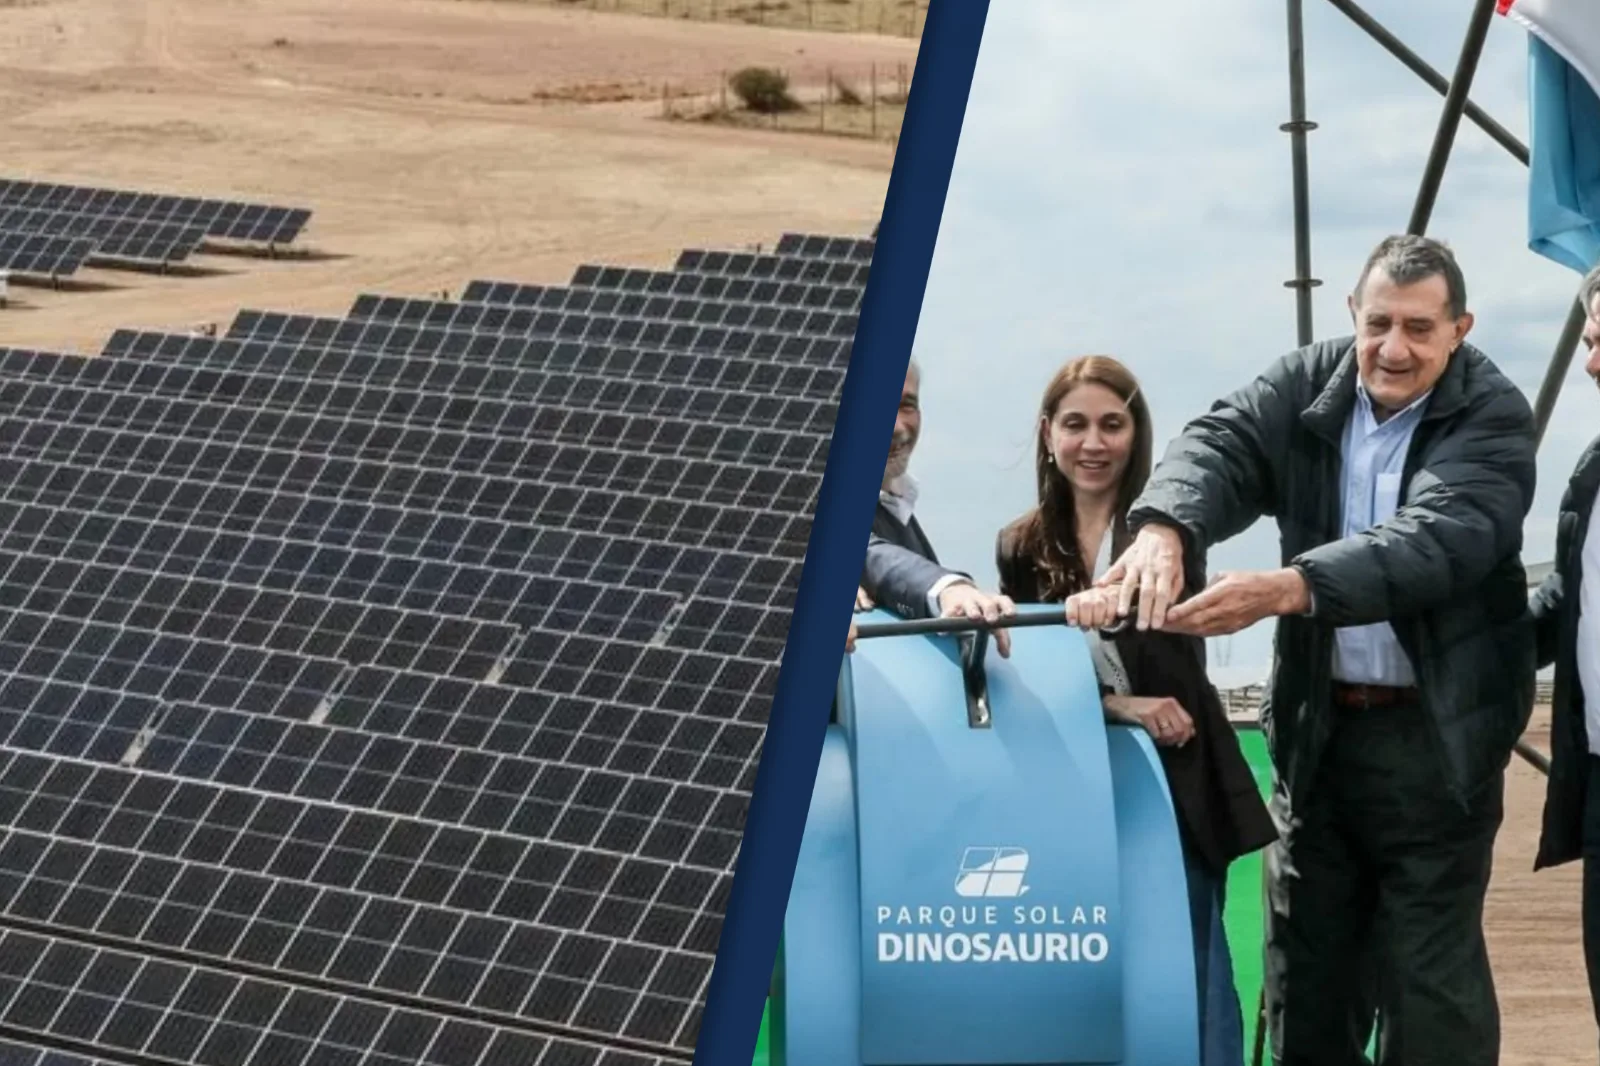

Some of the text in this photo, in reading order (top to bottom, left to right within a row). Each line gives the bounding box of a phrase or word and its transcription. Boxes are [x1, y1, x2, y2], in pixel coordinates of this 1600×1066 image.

[877, 906, 1107, 927] PARQUE SOLAR
[877, 932, 1109, 962] DINOSAURIO
